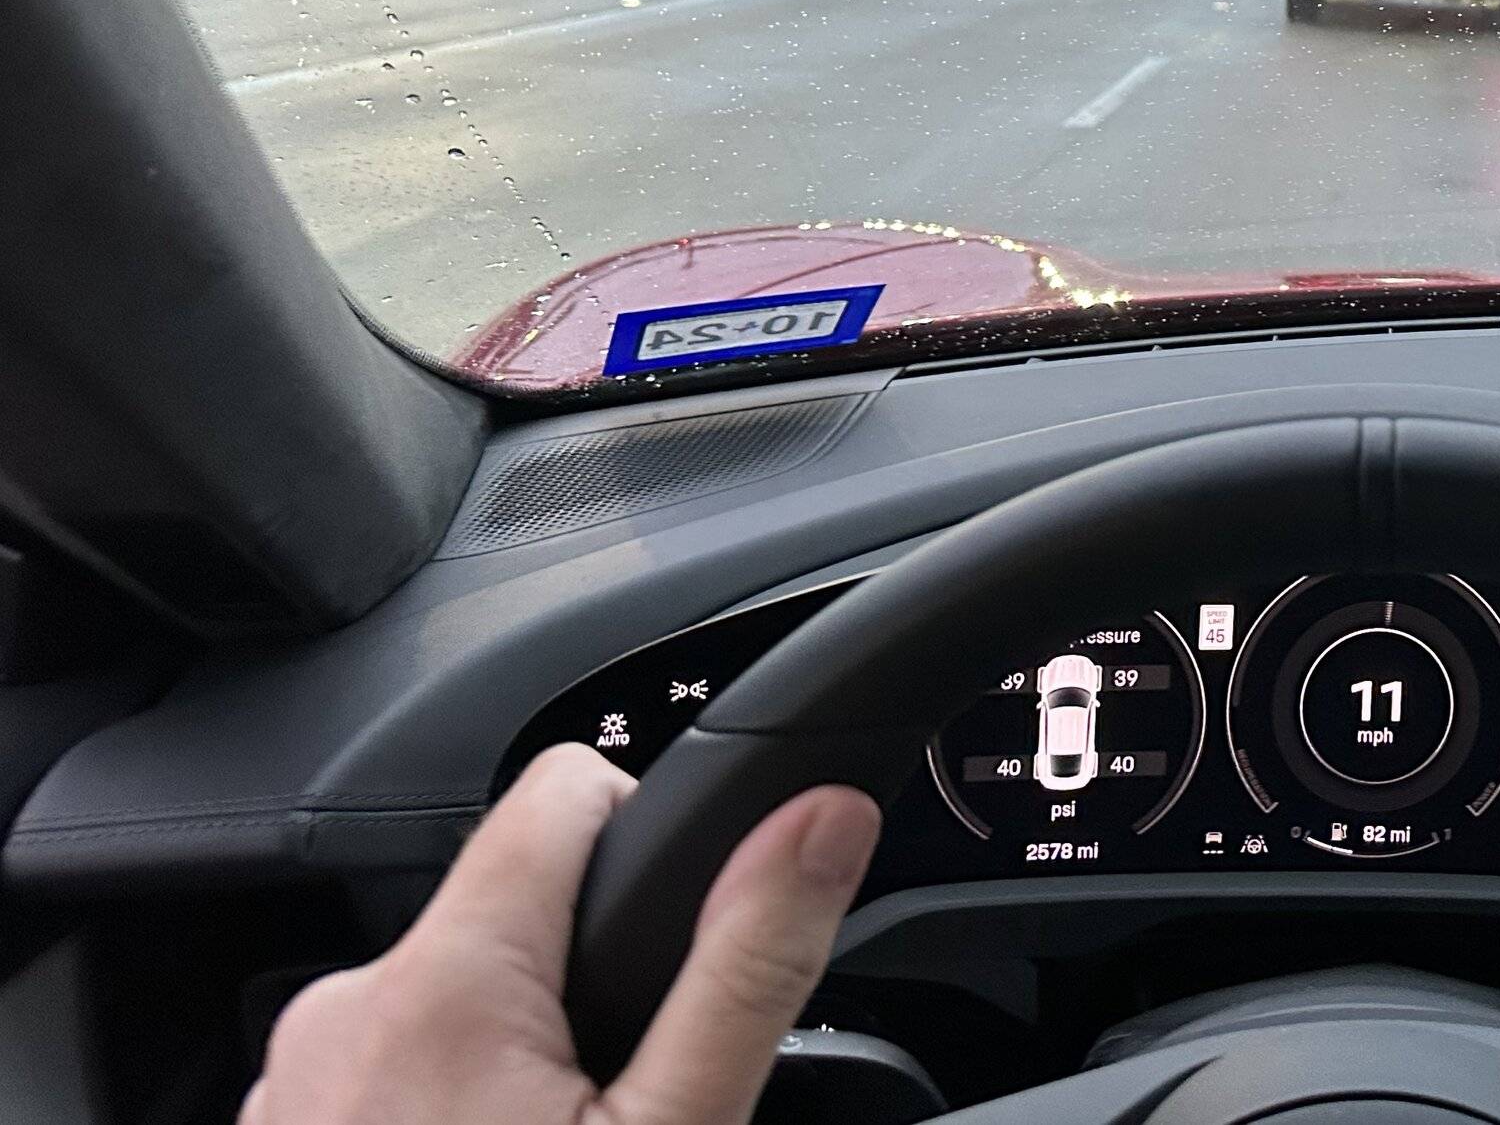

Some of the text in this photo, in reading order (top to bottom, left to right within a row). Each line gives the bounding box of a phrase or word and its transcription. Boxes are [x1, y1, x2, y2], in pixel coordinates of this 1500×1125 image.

[1205, 628, 1225, 643] 45
[1114, 669, 1139, 687] 39
[1350, 680, 1403, 722] 11
[596, 731, 630, 747] AUTO
[1357, 726, 1394, 747] mph
[996, 758, 1022, 777] 40
[1110, 755, 1135, 774] 40
[1050, 800, 1076, 822] psi
[1362, 825, 1411, 843] 82 mi
[1025, 841, 1099, 861] 2578 mi
